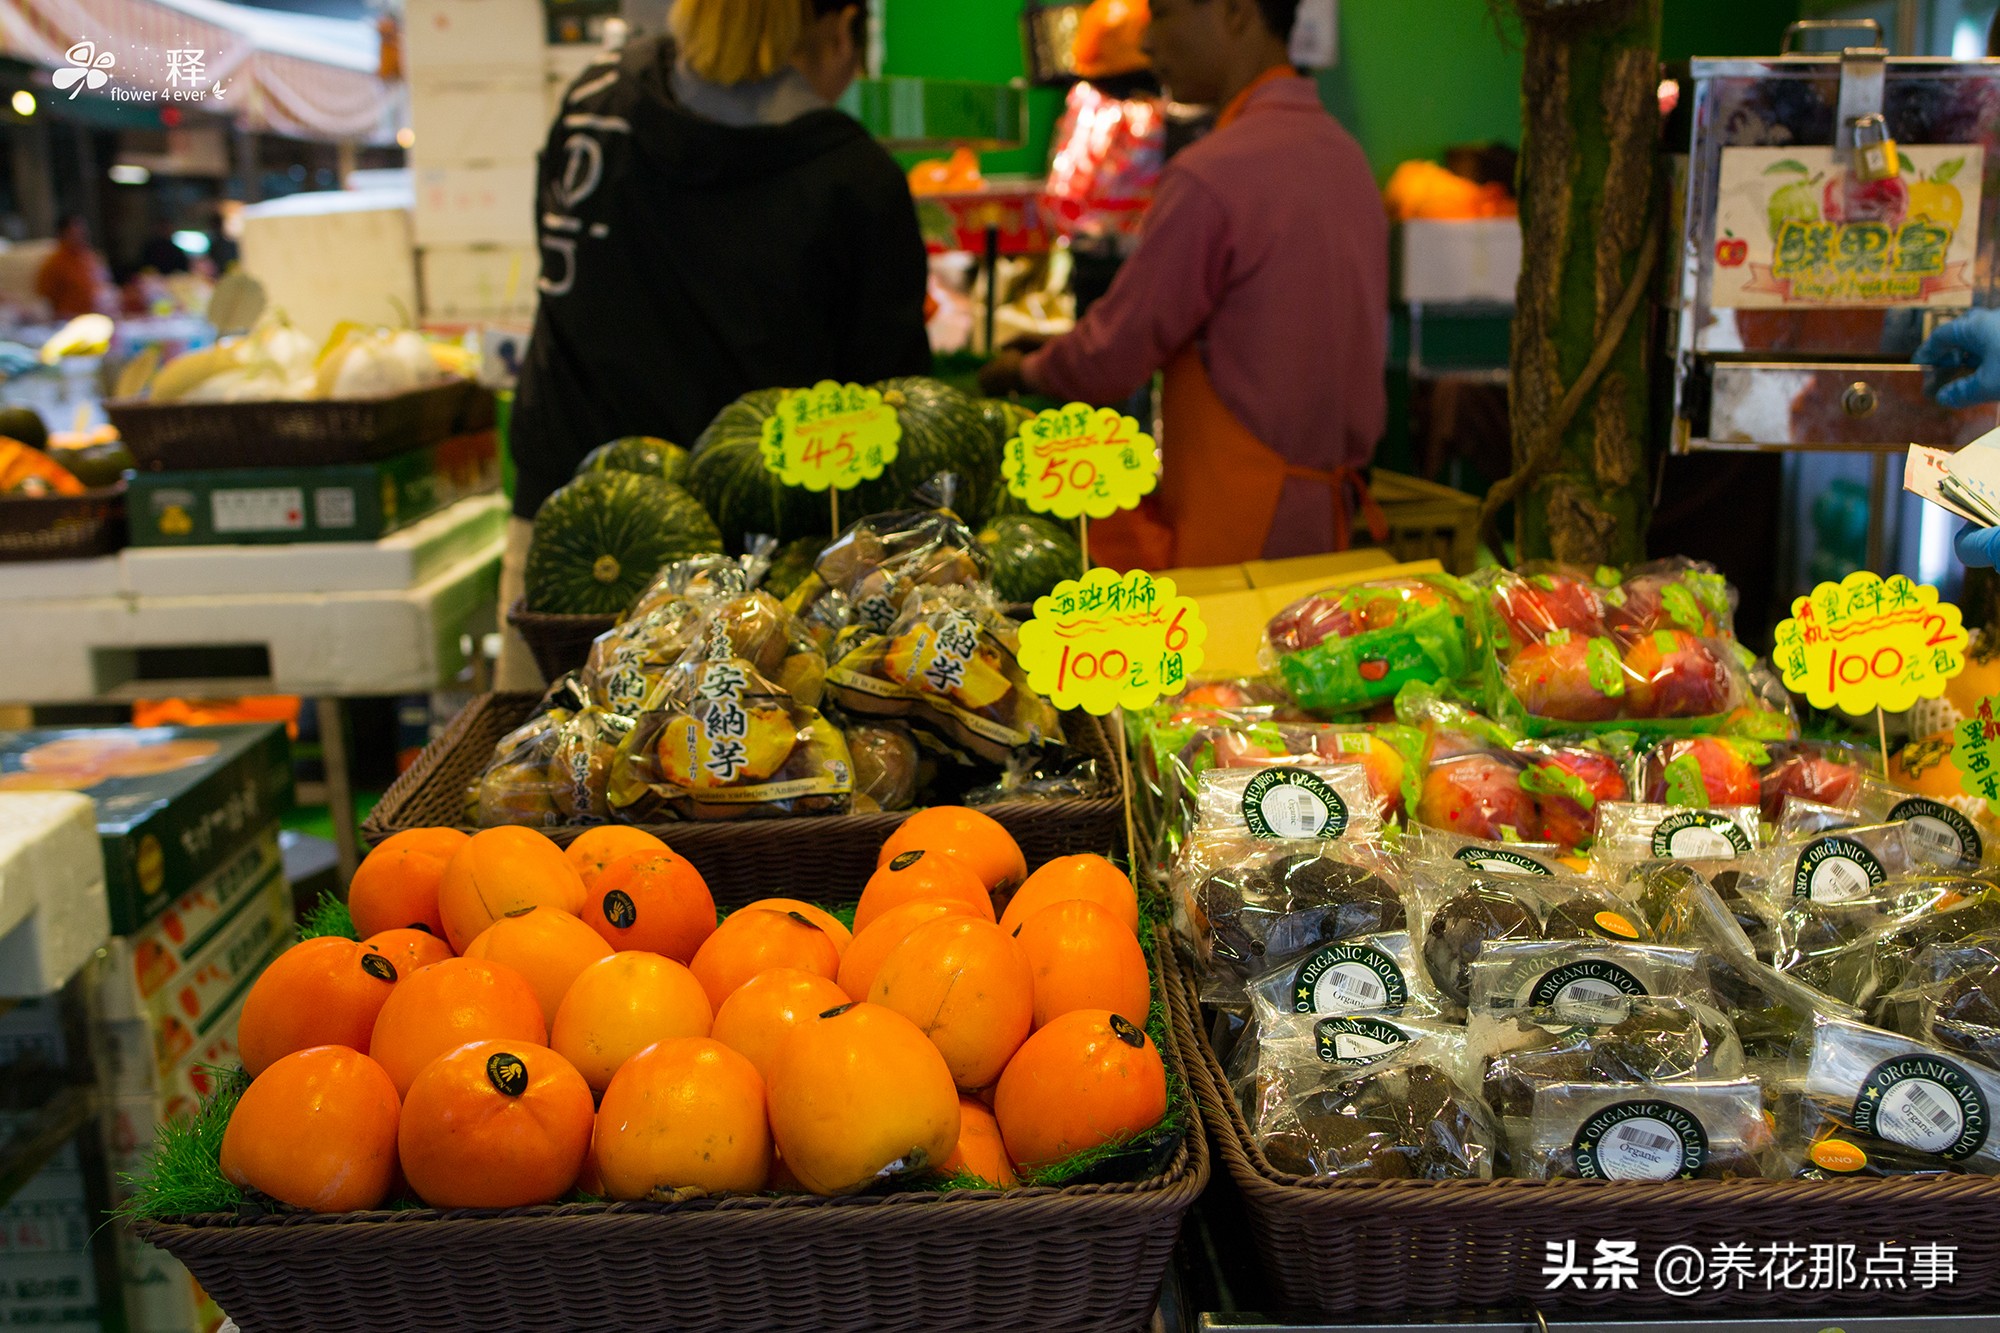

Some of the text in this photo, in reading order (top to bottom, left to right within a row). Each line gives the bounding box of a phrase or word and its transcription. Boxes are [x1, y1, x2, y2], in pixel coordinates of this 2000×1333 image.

[1777, 222, 1950, 276] 鮮果皇
[1050, 576, 1156, 616] 西班牙柿
[1165, 607, 1188, 651] 6
[1923, 614, 1958, 648] 2
[702, 665, 747, 778] 安納芋
[1809, 842, 1865, 863] ORGANIC
[1302, 947, 1362, 984] ORGANIC
[1539, 964, 1601, 1000] ORGANIC
[1877, 1062, 1958, 1087] ORGANIC
[1954, 1084, 1983, 1154] AVOCADO
[1902, 1103, 1935, 1138] Organic
[1586, 1104, 1659, 1138] ORGANIC
[1660, 1110, 1701, 1170] AVOCADO
[1619, 1143, 1662, 1164] Organic
